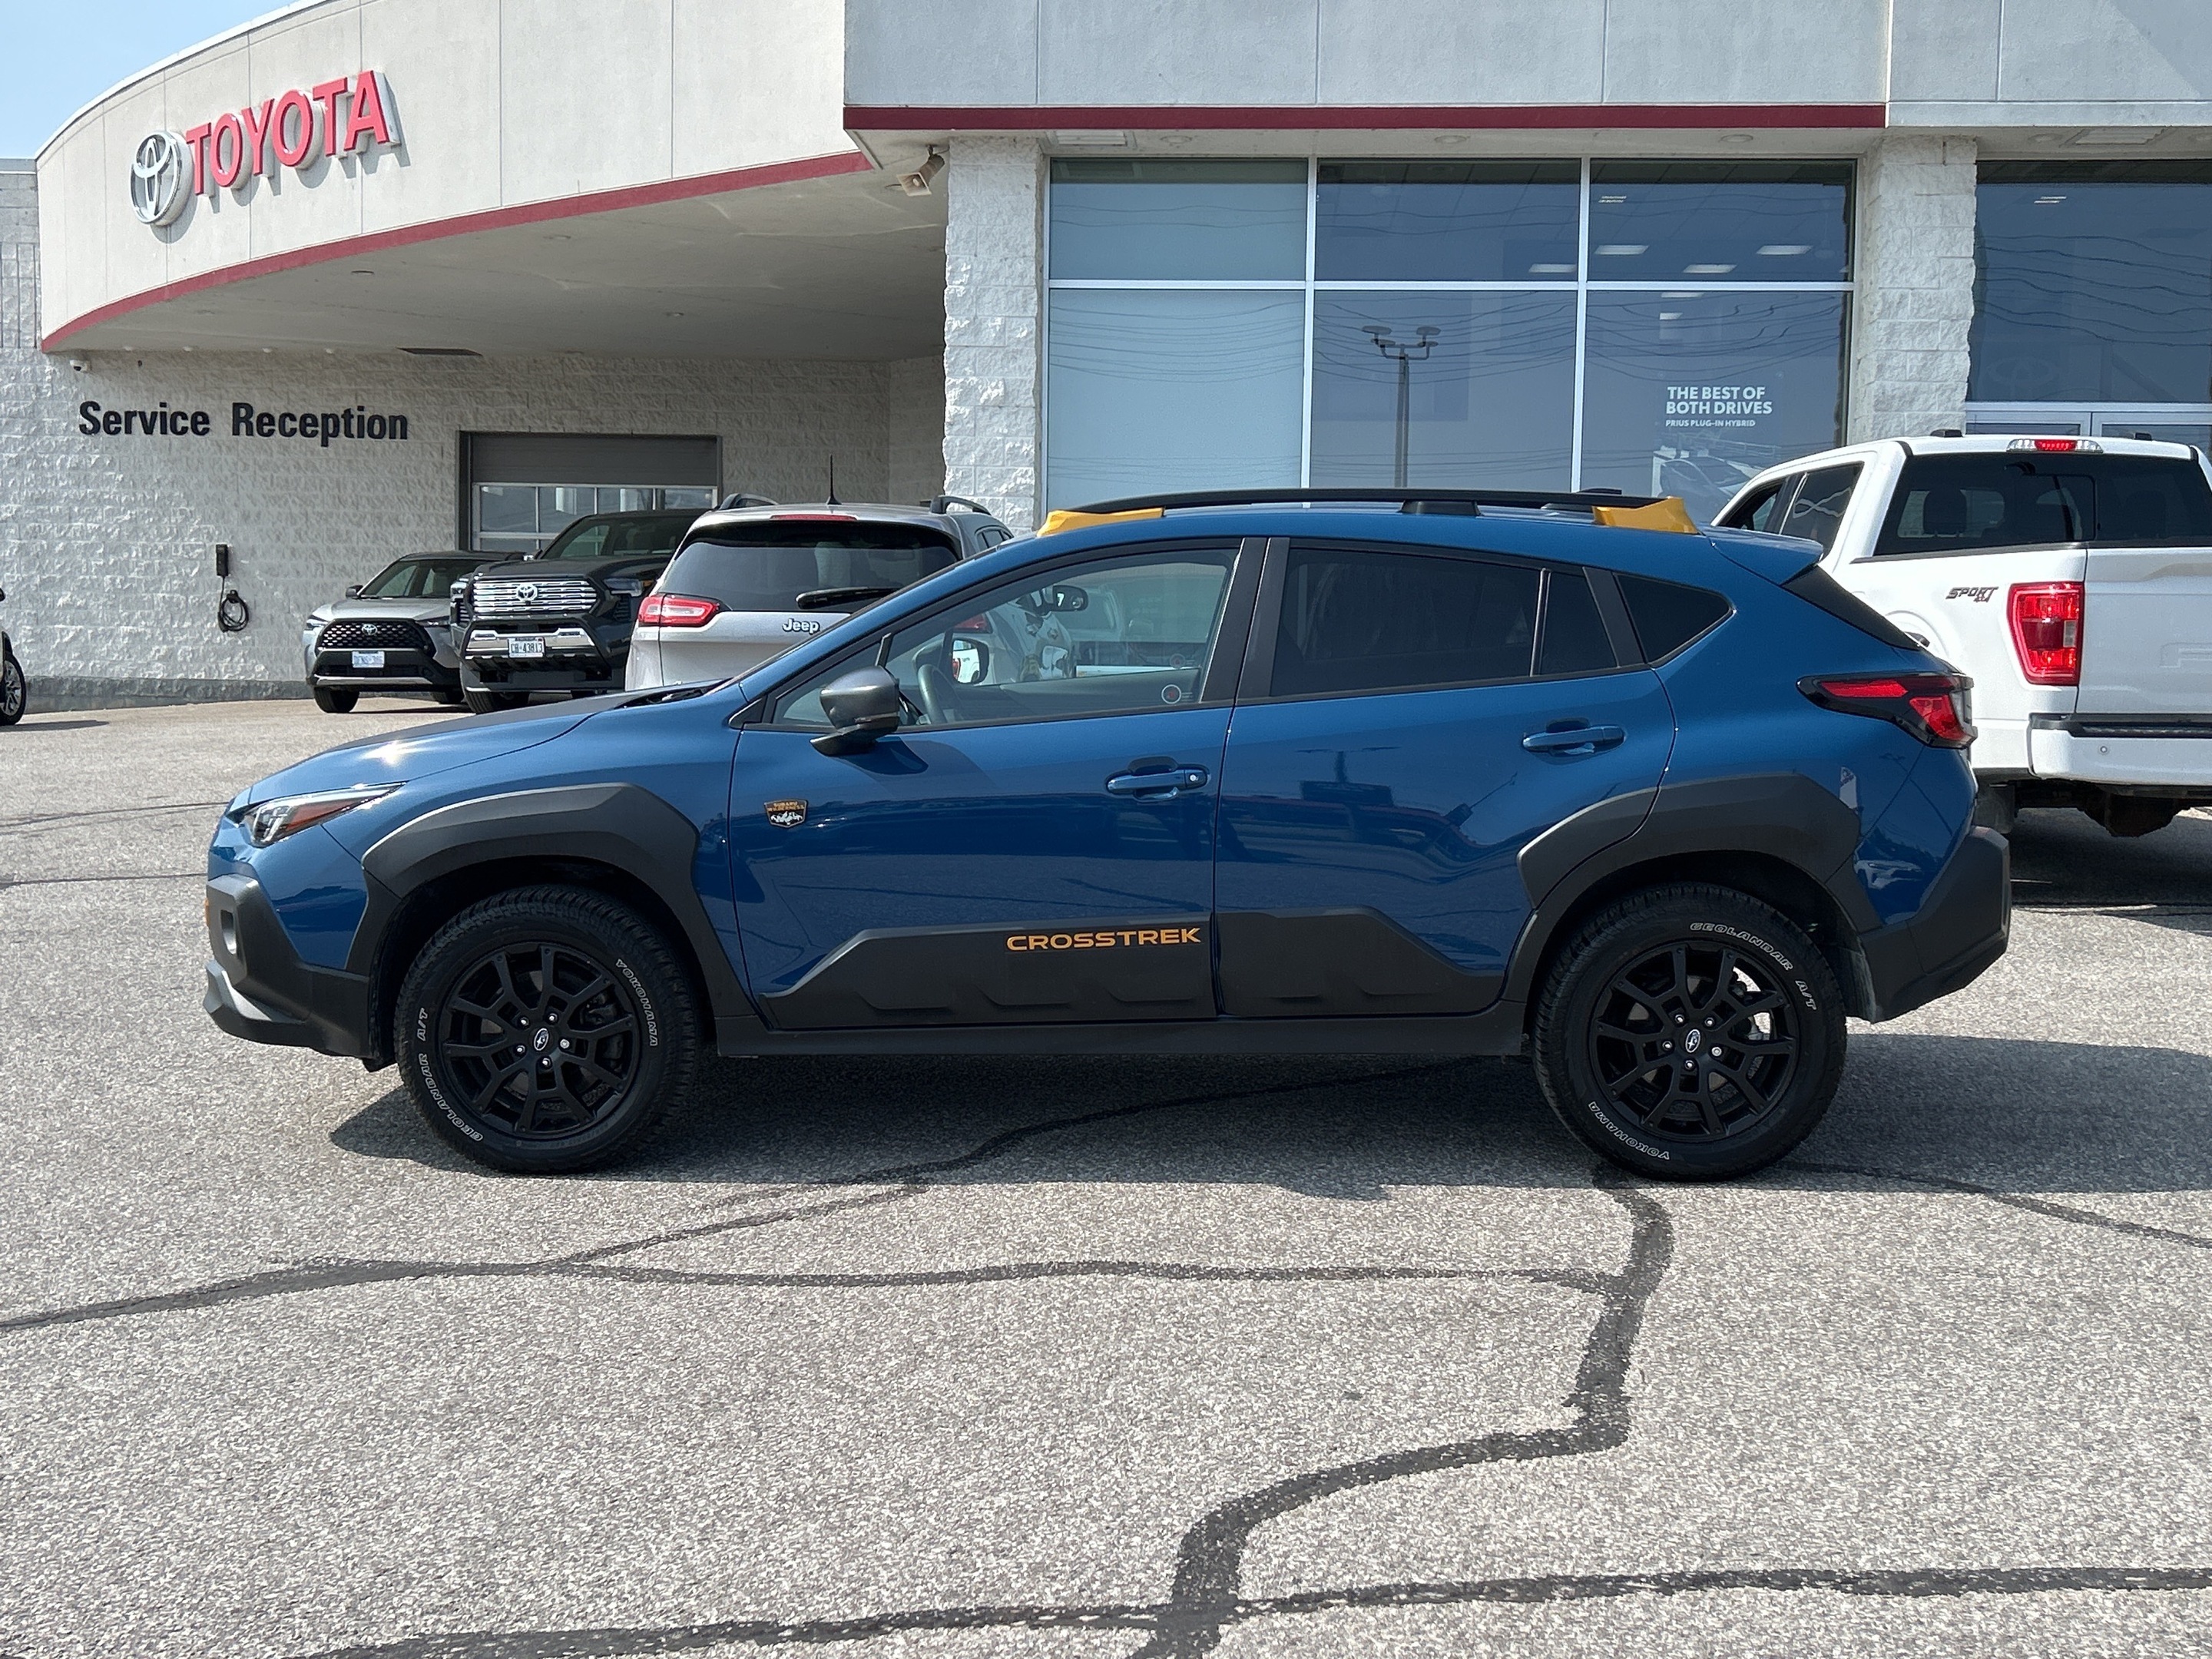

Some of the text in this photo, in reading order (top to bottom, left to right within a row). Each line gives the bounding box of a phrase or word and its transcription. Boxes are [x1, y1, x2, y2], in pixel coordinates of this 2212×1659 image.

[186, 70, 392, 197] TOYOTA
[1666, 401, 1773, 414] BOTH DRIVES
[1667, 386, 1765, 399] THE BEST OF
[79, 401, 409, 447] Service Reception
[1945, 586, 1999, 601] SPORT
[783, 618, 820, 634] Jeep
[1007, 928, 1201, 950] CROSSTREK
[1690, 922, 1817, 1011] GEOLANDAR A/T
[615, 959, 658, 1046] YOKOHAMA
[416, 1008, 484, 1142] GEOLANDAR A/T
[1588, 1101, 1671, 1161] YOKOHAMA
